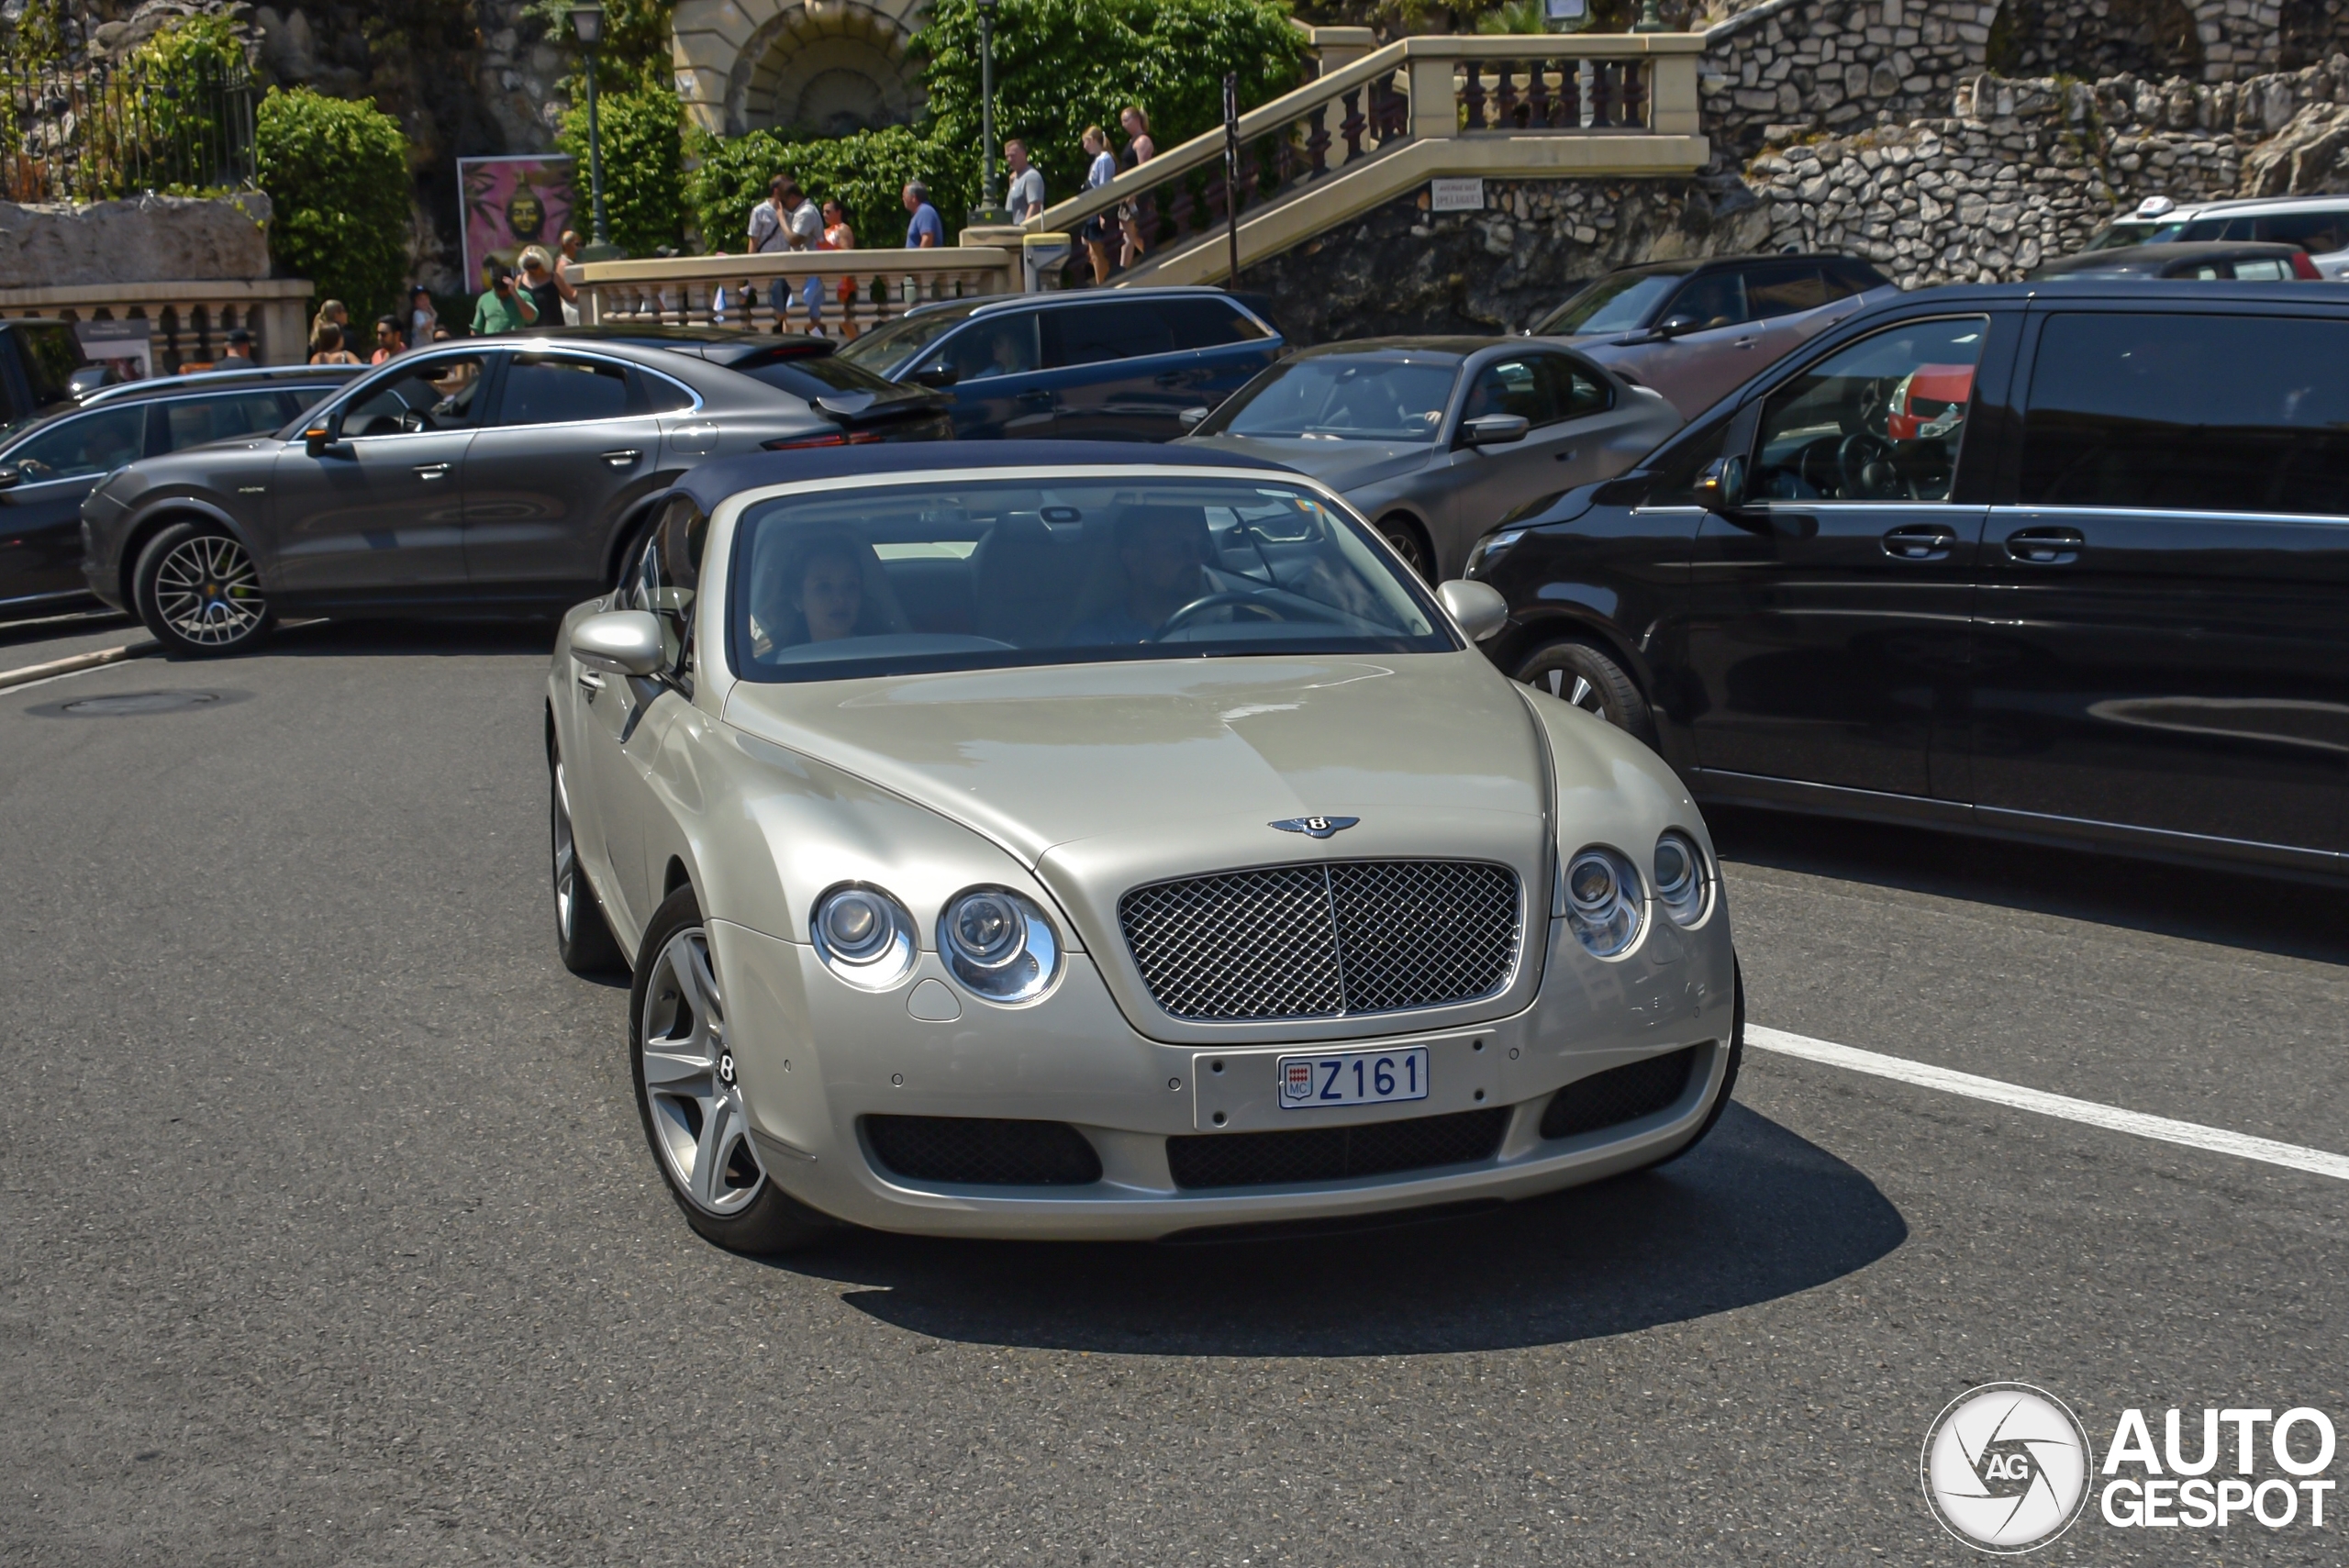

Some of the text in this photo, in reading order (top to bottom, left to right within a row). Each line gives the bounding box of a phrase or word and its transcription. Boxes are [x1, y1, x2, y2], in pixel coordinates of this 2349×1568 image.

[720, 1055, 733, 1082] B
[1319, 1055, 1416, 1100] Z161
[1289, 1083, 1308, 1094] MC
